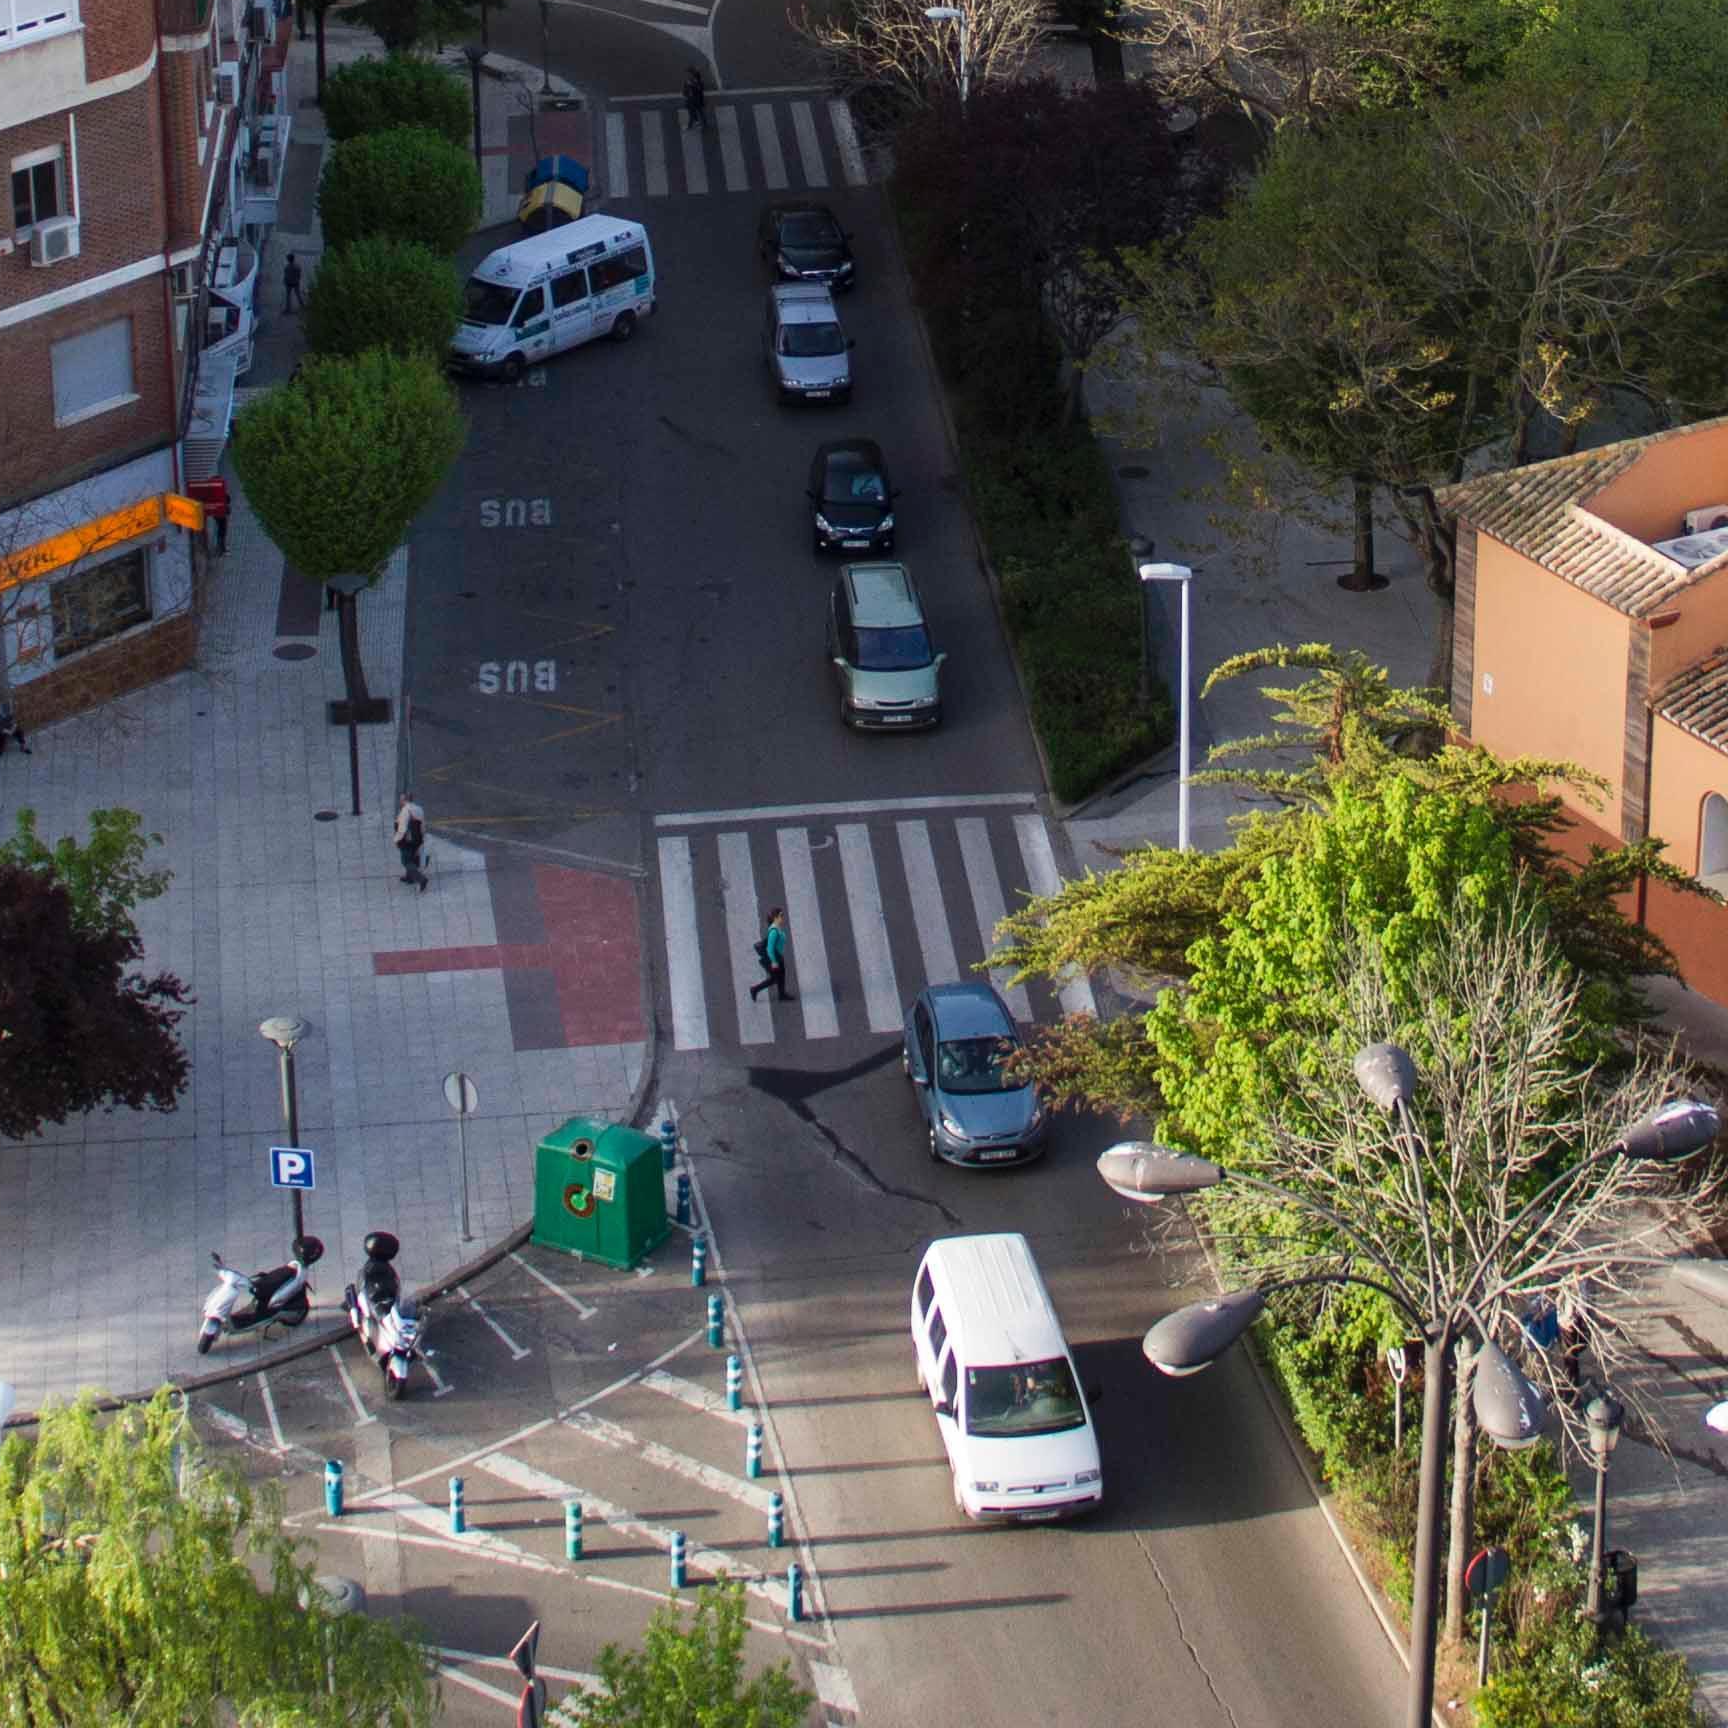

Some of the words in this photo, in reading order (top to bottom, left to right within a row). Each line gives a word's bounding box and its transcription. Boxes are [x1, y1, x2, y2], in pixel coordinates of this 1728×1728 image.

[479, 498, 551, 528] BUS
[478, 659, 556, 694] BUS
[278, 1152, 305, 1183] P
